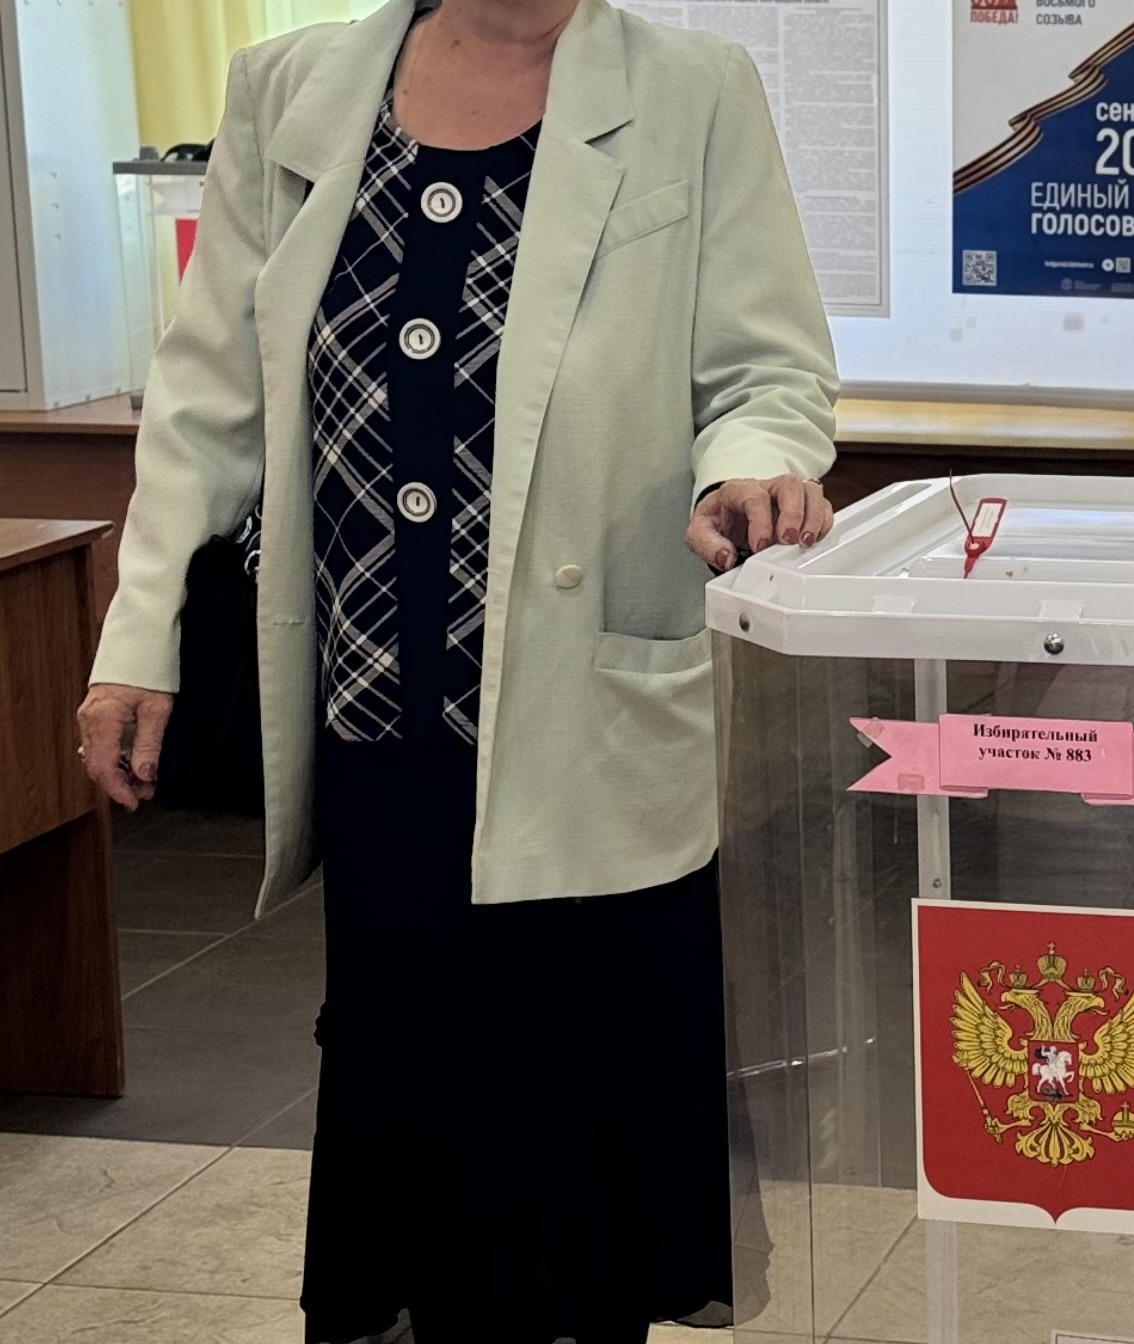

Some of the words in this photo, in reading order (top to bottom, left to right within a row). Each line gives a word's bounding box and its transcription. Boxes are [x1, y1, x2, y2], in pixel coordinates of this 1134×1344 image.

[970, 10, 1019, 25] ПОБЕДА!
[1036, 14, 1082, 26] СОЗЫВА
[1031, 178, 1129, 211] ЕДИНЫЙ
[973, 723, 1098, 742] Избирательный
[978, 746, 1041, 761] участок
[1043, 747, 1062, 761] №
[1066, 747, 1092, 763] 883
